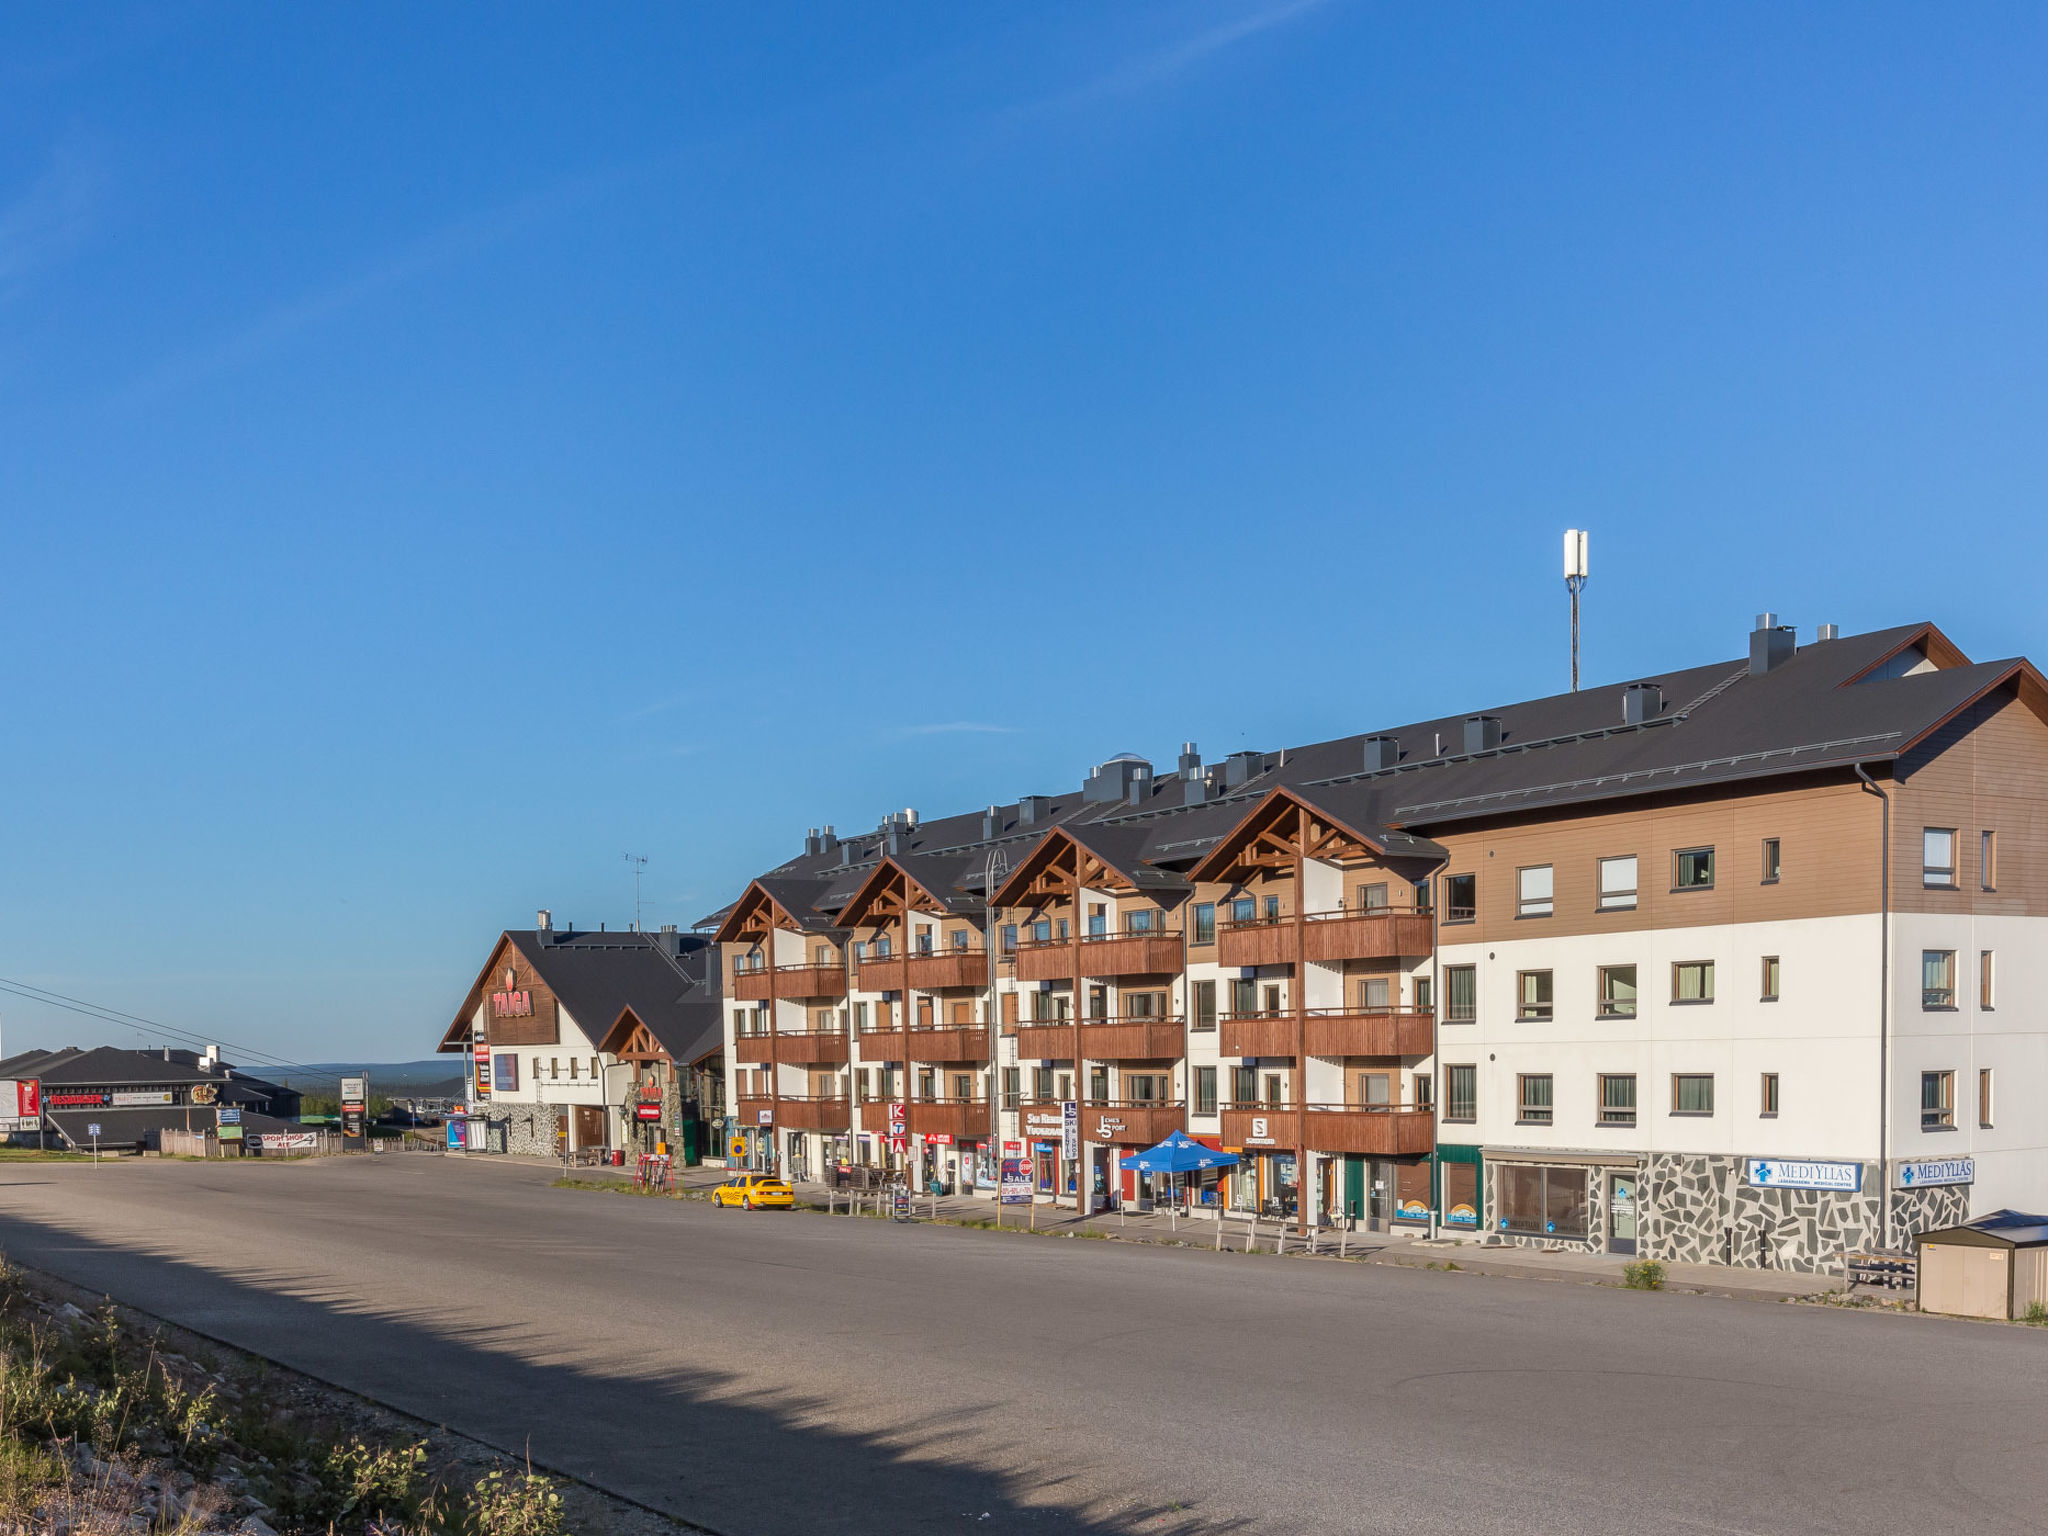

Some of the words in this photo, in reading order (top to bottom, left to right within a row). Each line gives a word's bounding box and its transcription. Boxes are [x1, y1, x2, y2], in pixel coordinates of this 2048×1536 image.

[493, 991, 531, 1017] TAIGA
[50, 1094, 103, 1105] HESBURGER
[1778, 1163, 1852, 1181] MEDIYLLÄS
[1917, 1160, 1972, 1179] MEDIYLLÄS
